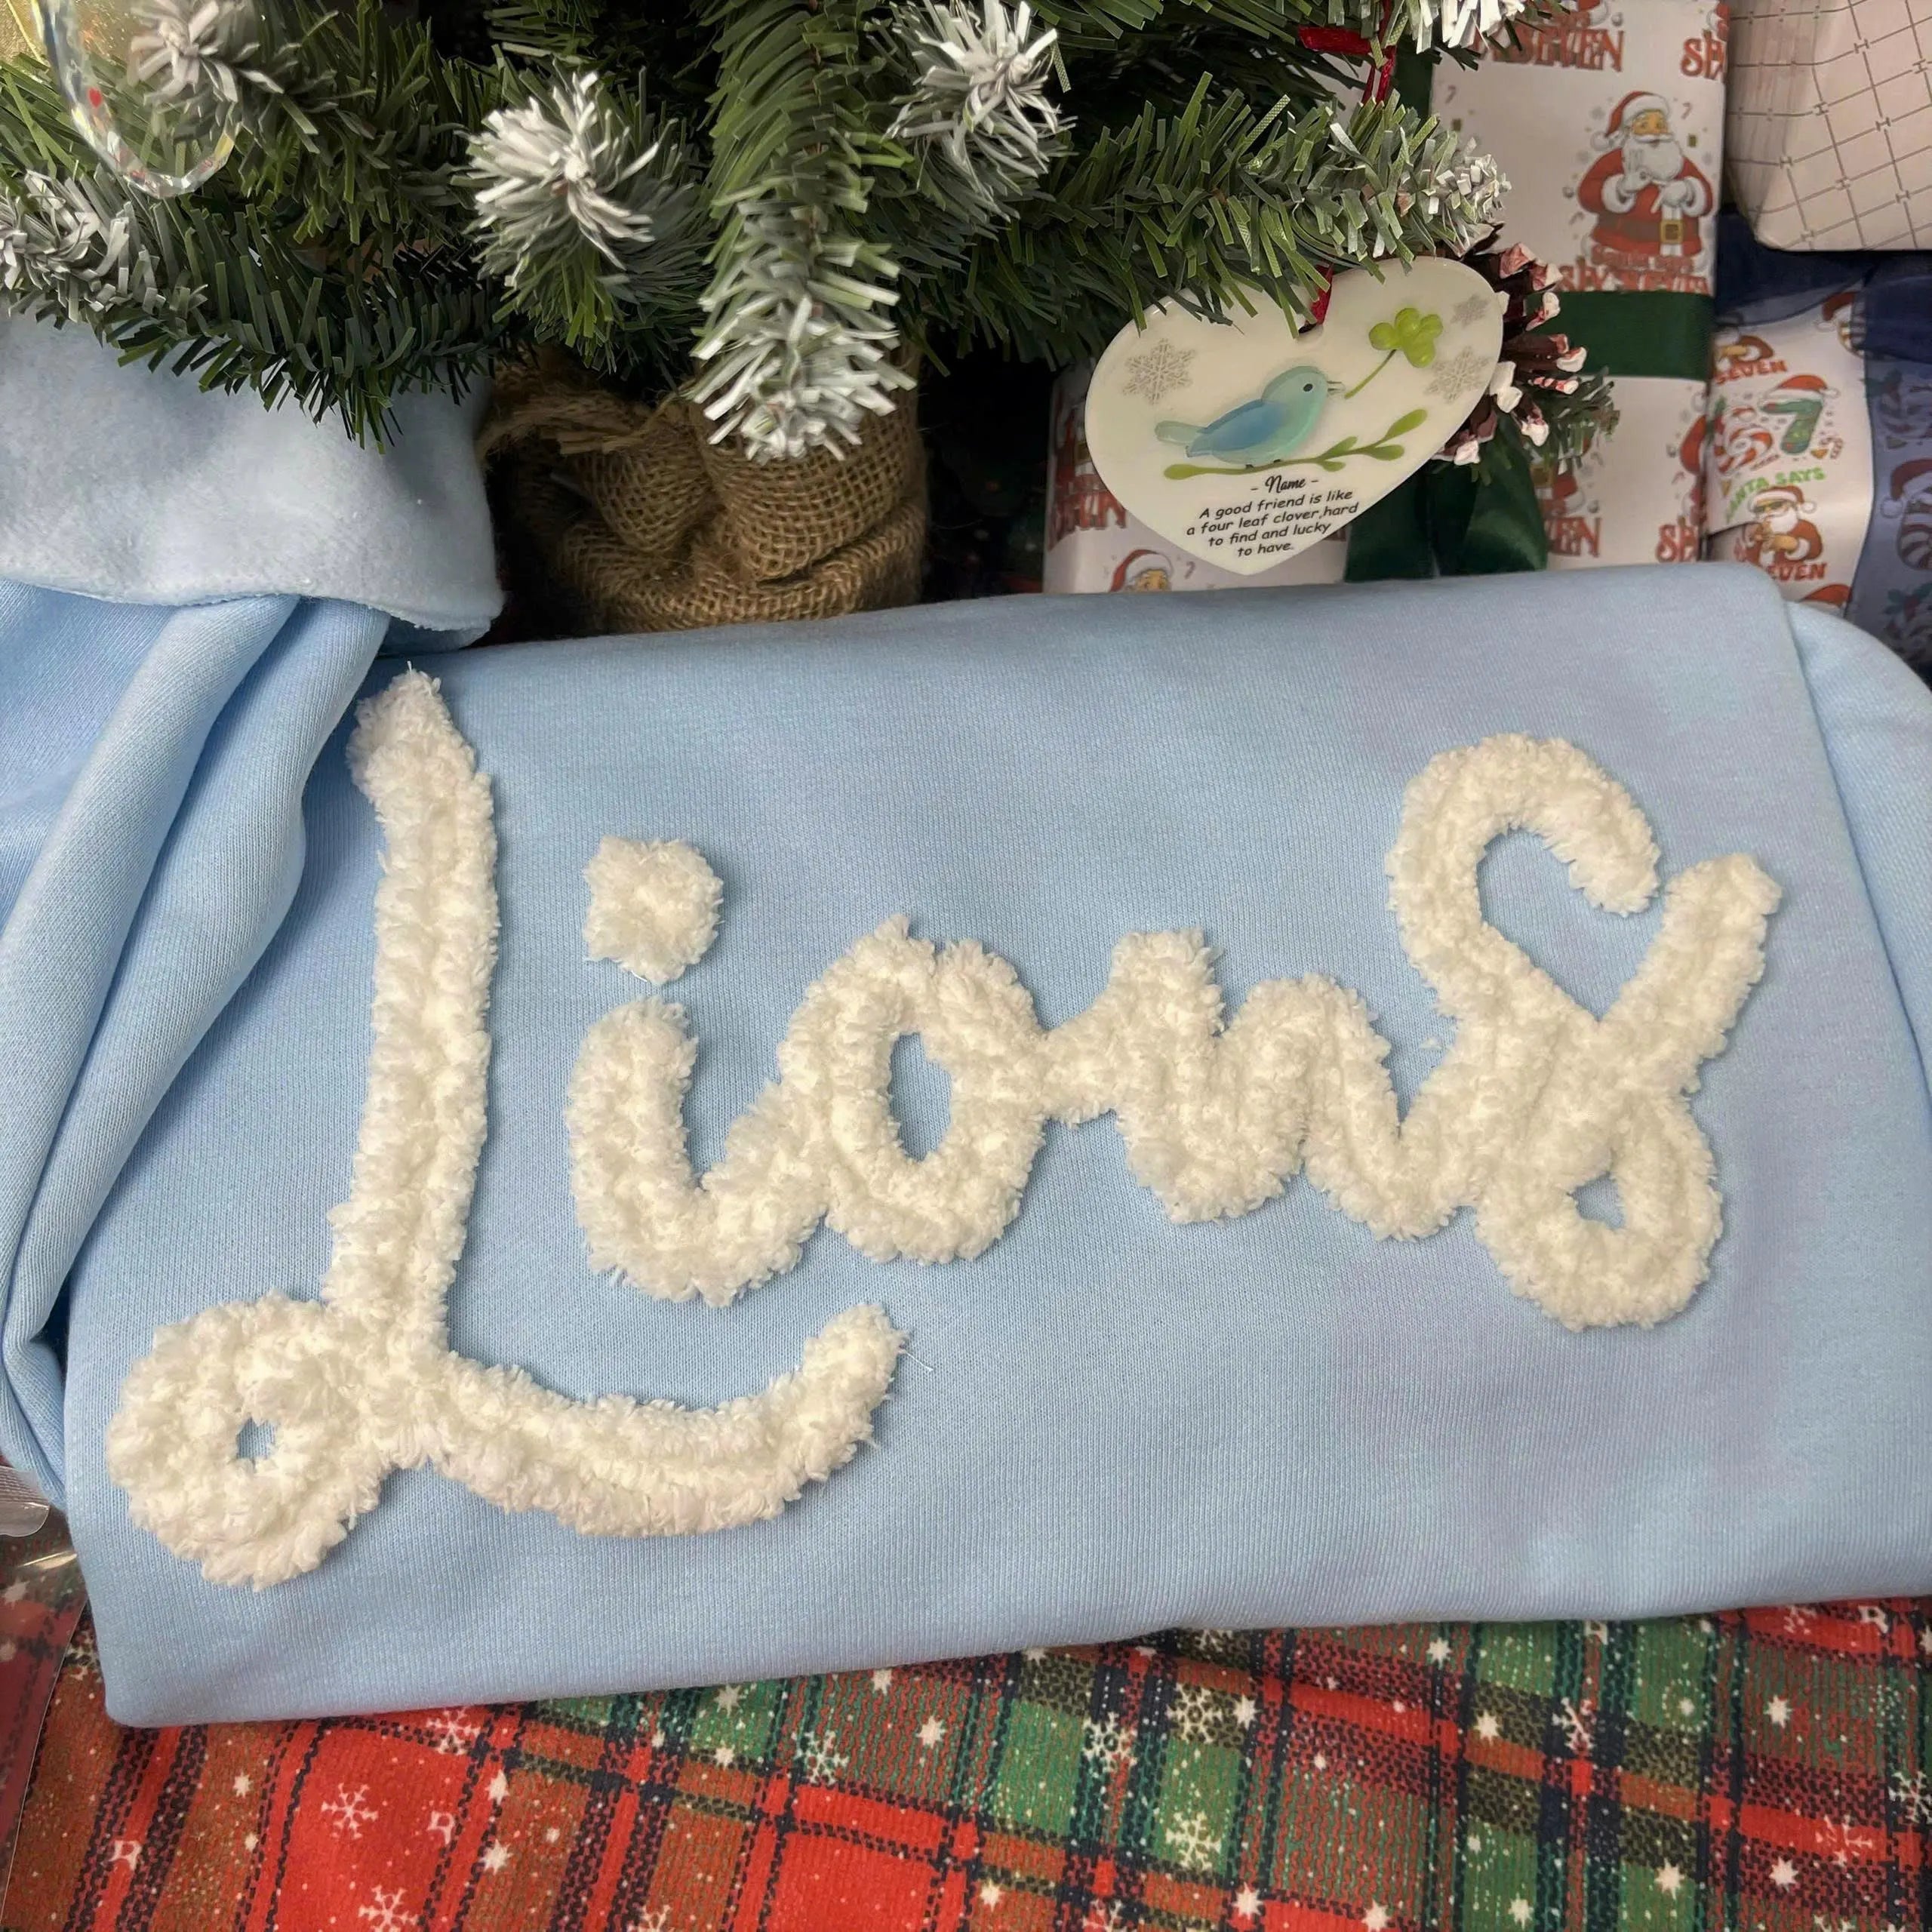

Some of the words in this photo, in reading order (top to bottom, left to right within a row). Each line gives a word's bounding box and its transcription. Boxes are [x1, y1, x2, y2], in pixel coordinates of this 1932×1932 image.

[1265, 475, 1306, 494] Name
[1199, 508, 1209, 518] A
[1215, 501, 1253, 520] good
[1257, 494, 1305, 512] friend
[1310, 494, 1321, 504] is
[1326, 490, 1353, 502] like
[1186, 527, 1195, 535] a
[1201, 521, 1234, 534] four
[1238, 514, 1269, 528] leaf
[1208, 537, 1223, 547] to
[1230, 530, 1259, 545] find
[1261, 526, 1289, 540] and
[1293, 521, 1331, 535] lucky
[1237, 547, 1253, 557] to
[106, 668, 1784, 1592] Lions
